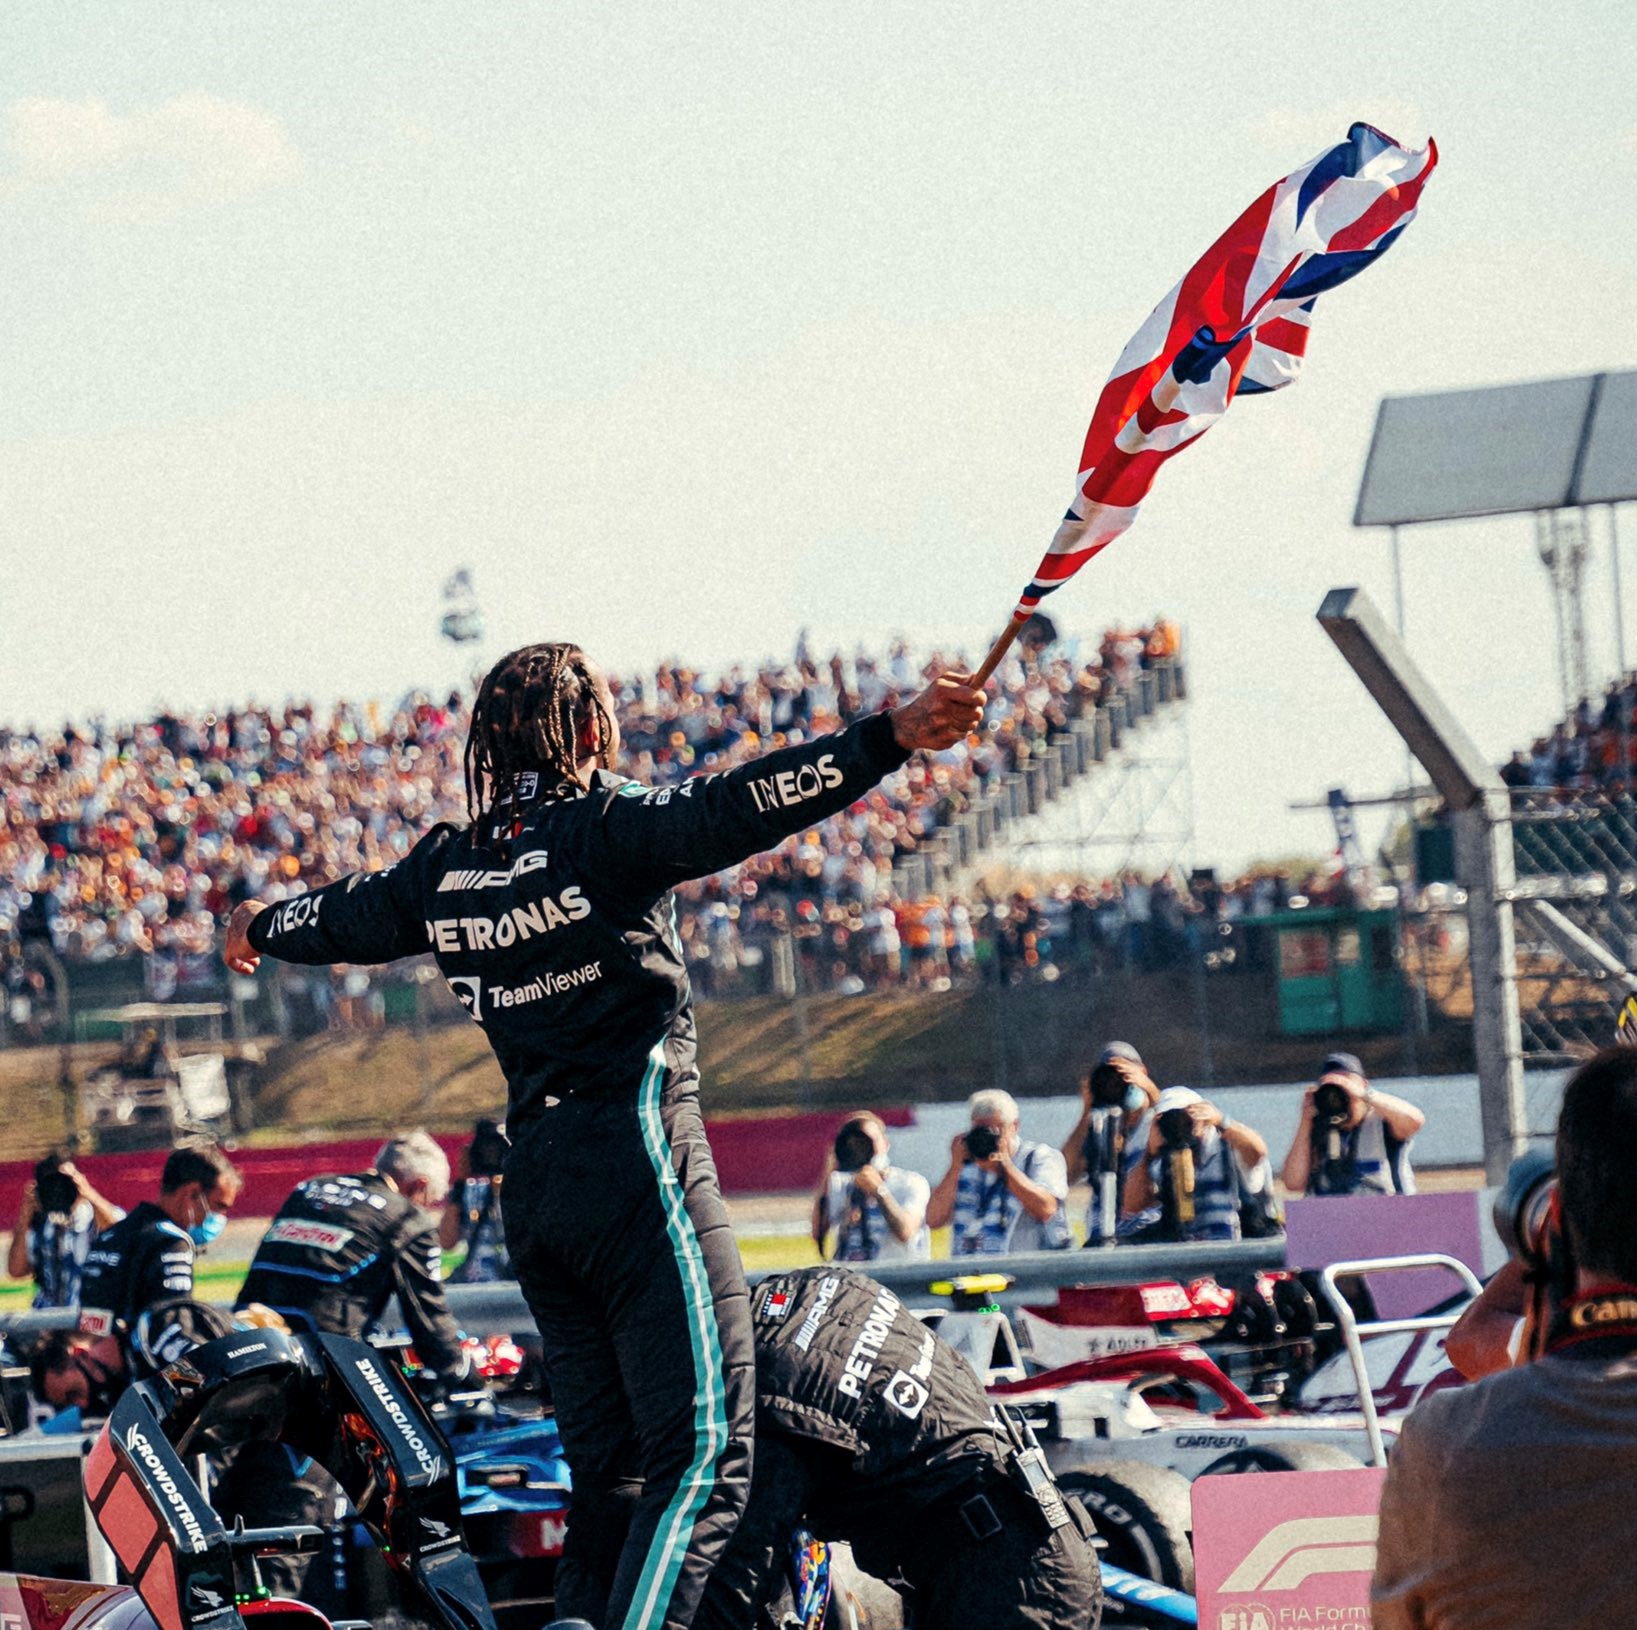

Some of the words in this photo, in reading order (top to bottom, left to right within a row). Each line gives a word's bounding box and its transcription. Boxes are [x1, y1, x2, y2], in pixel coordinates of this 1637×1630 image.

[747, 754, 844, 814] INEOS
[489, 960, 602, 1008] TeamViewer
[227, 1343, 267, 1359] HAMILTON
[354, 1357, 434, 1474] CROWDSTRIKE
[132, 1432, 208, 1554] CROWDSTRIKE
[1280, 1607, 1312, 1622] FIA
